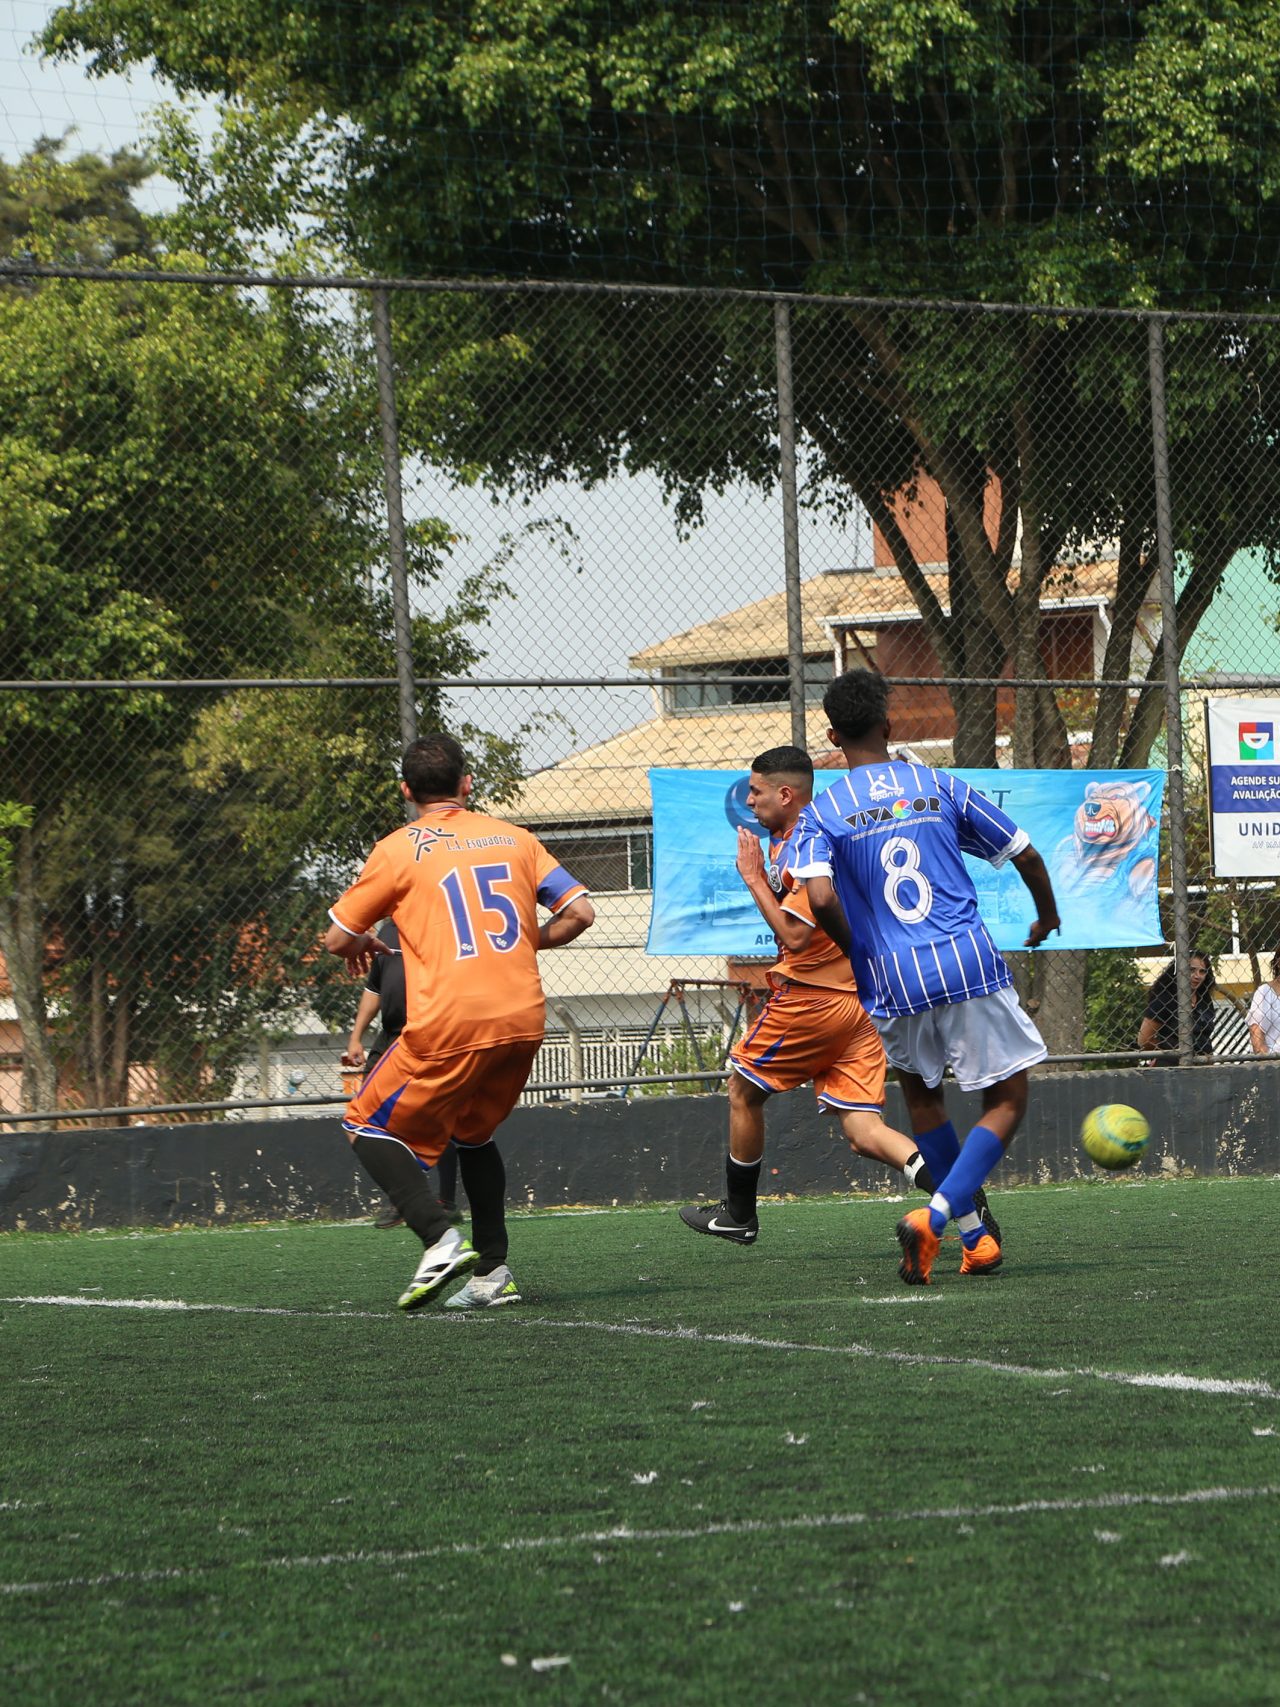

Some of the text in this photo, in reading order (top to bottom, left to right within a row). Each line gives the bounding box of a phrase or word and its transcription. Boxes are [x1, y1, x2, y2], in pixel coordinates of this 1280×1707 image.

[1231, 776, 1267, 786] AGENDE
[843, 796, 942, 831] VIVACOR
[466, 835, 517, 849] Esquadrias
[880, 836, 934, 925] 8
[438, 862, 521, 961] 15
